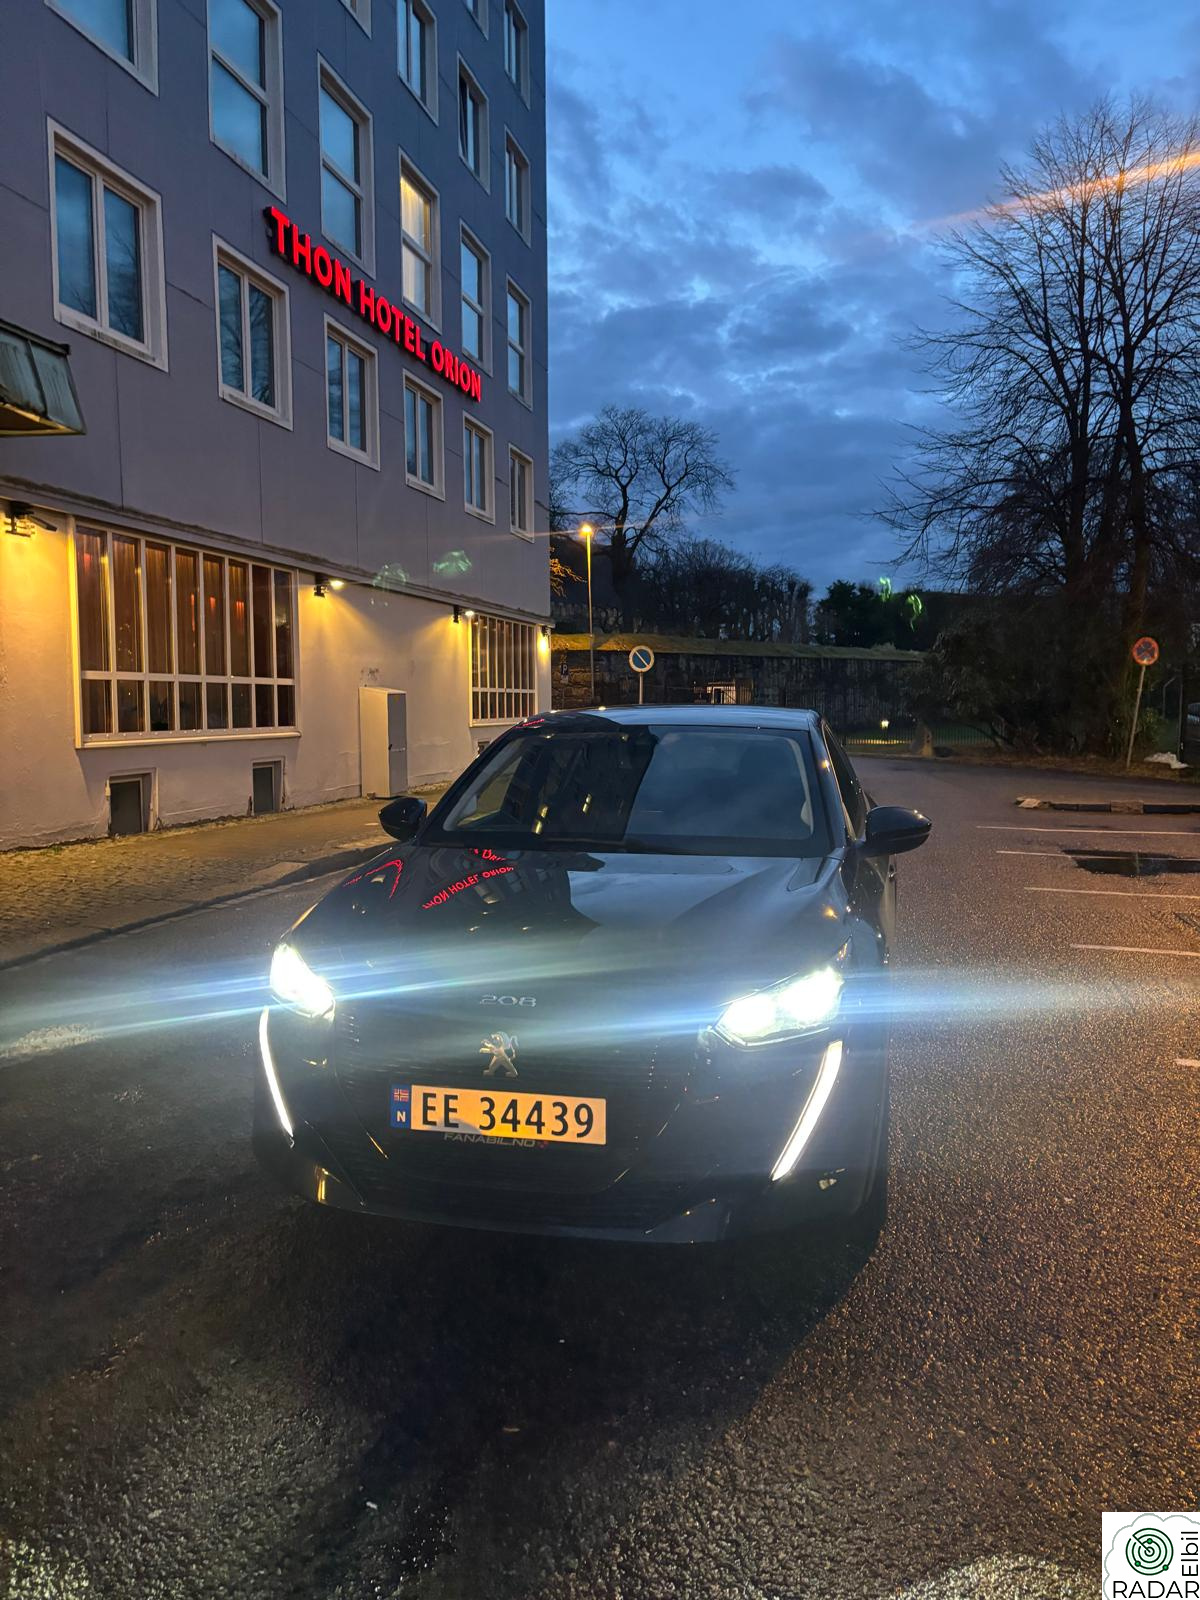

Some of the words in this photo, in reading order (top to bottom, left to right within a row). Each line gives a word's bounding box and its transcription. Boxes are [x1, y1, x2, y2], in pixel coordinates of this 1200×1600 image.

[270, 206, 352, 305] THON
[359, 279, 426, 361] HOTEL
[431, 340, 482, 402] ORION
[479, 994, 537, 1007] 208
[396, 1111, 406, 1123] N
[422, 1092, 460, 1129] EE
[478, 1096, 594, 1138] 34439
